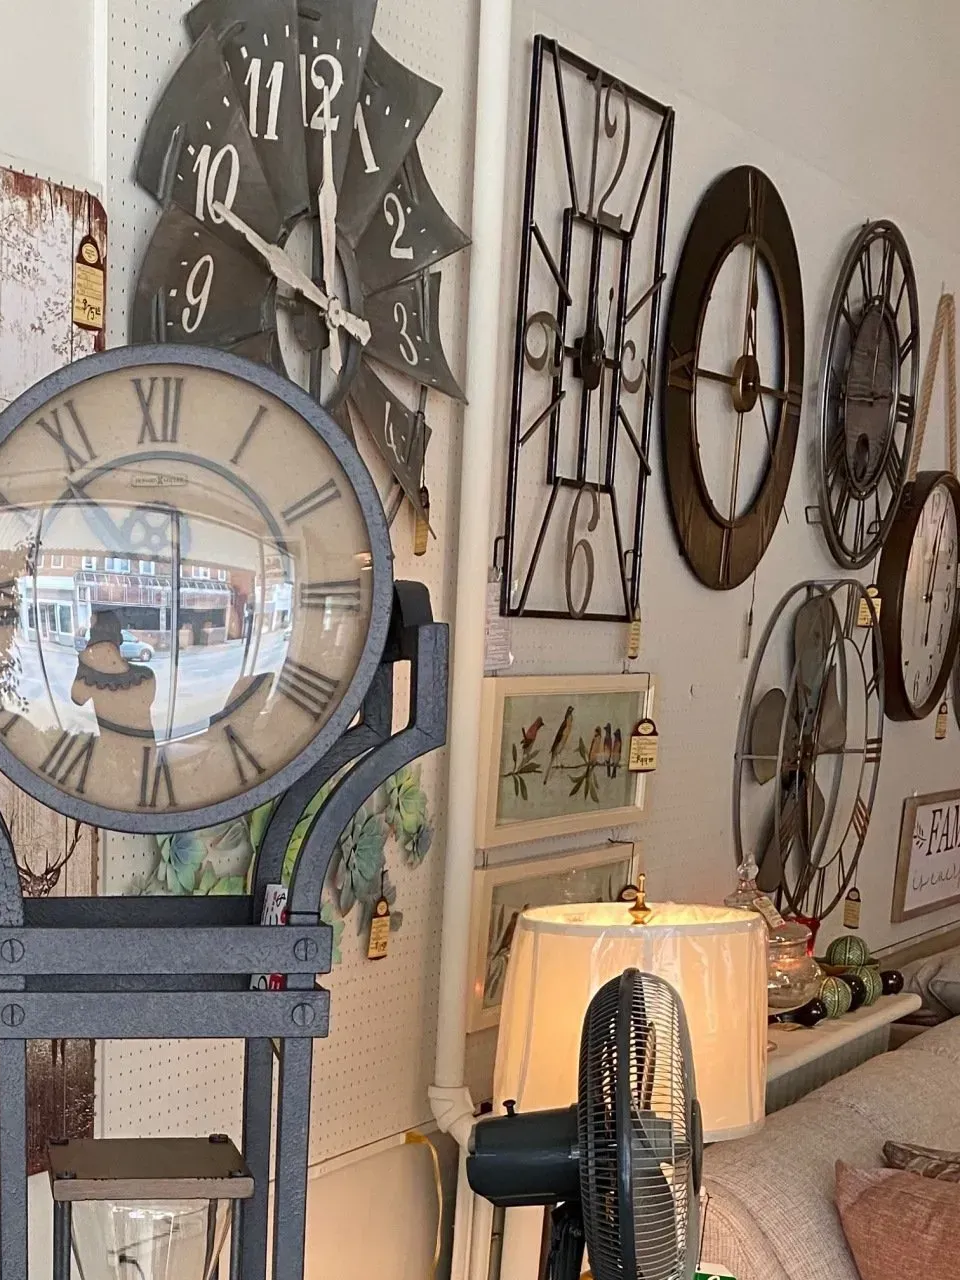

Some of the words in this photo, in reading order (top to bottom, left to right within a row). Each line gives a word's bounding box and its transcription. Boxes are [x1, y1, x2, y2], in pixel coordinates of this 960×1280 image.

[244, 58, 285, 141] 11
[299, 53, 344, 132] 12
[353, 102, 380, 173] 1
[586, 68, 631, 234] 12
[192, 143, 240, 225] 10
[383, 191, 415, 260] 2
[181, 254, 215, 334] 9
[393, 301, 420, 367] 3
[36, 400, 97, 473] XI
[131, 376, 185, 444] XII
[230, 404, 268, 465] I
[384, 401, 402, 464] 4
[281, 478, 342, 526] II
[564, 484, 600, 620] 6
[300, 576, 362, 613] III
[138, 745, 178, 808] VI
[223, 723, 267, 785] V
